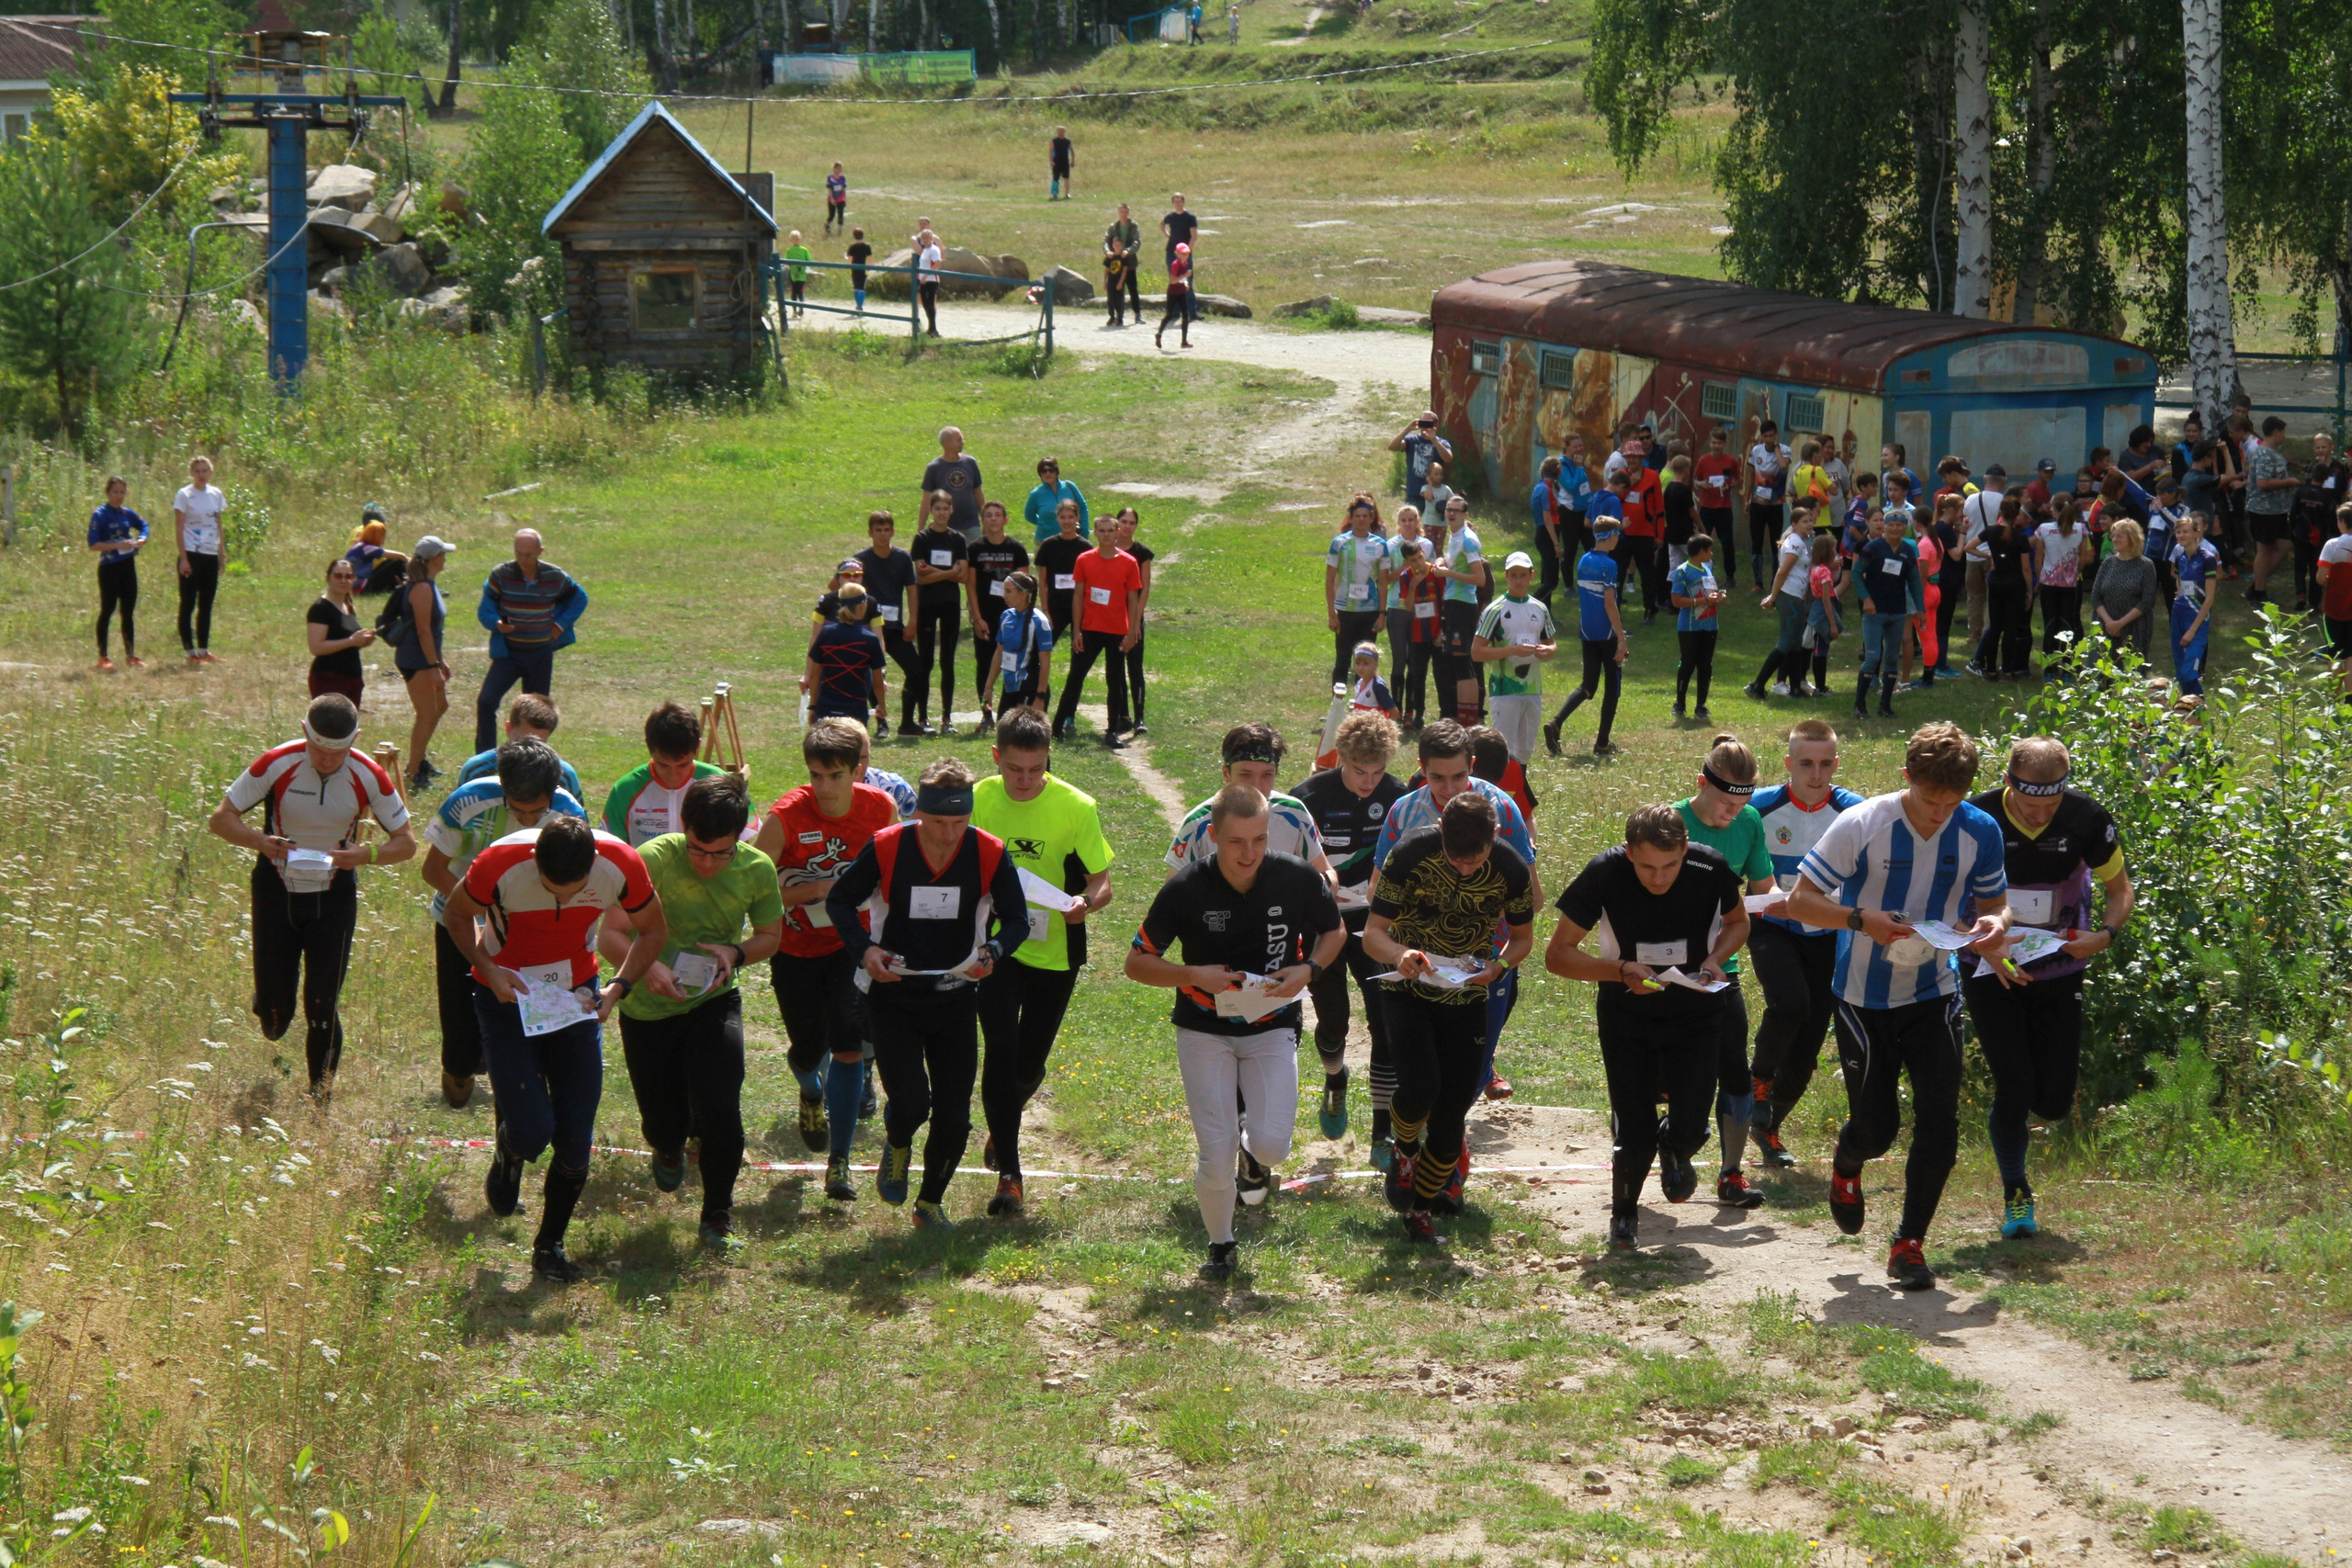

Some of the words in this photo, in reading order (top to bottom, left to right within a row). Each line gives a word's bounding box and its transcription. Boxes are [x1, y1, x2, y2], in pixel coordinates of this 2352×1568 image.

[941, 893, 948, 903] 7
[2032, 897, 2038, 907] 1
[1666, 948, 1673, 956] 3
[544, 973, 559, 983] 20
